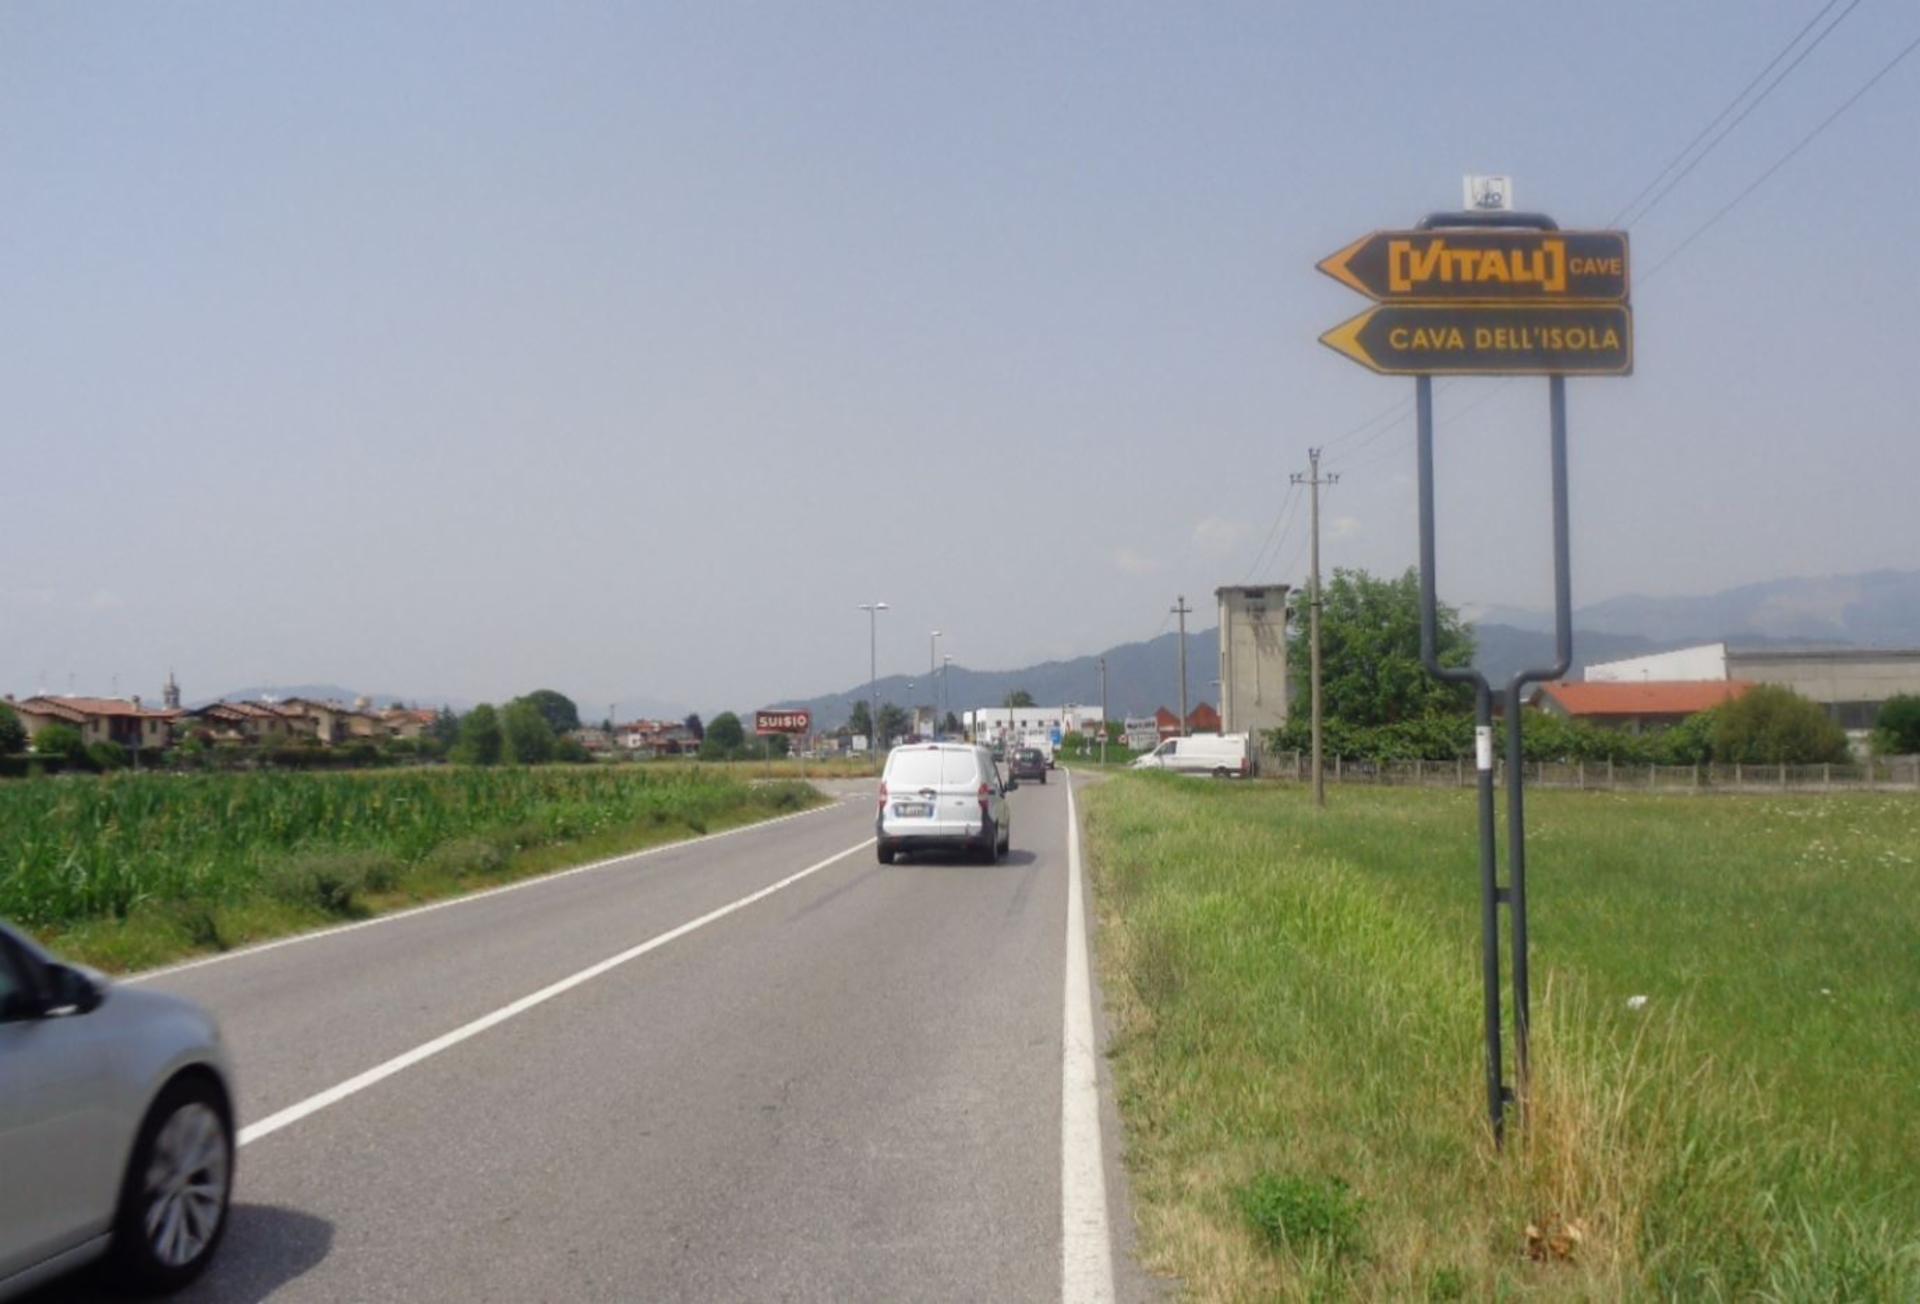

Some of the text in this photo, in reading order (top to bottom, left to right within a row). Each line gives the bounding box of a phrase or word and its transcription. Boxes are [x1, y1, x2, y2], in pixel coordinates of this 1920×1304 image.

[1569, 257, 1621, 276] CAVE
[1389, 327, 1619, 350] CAVA DELL'ISOLA
[759, 714, 807, 728] SUISIO
